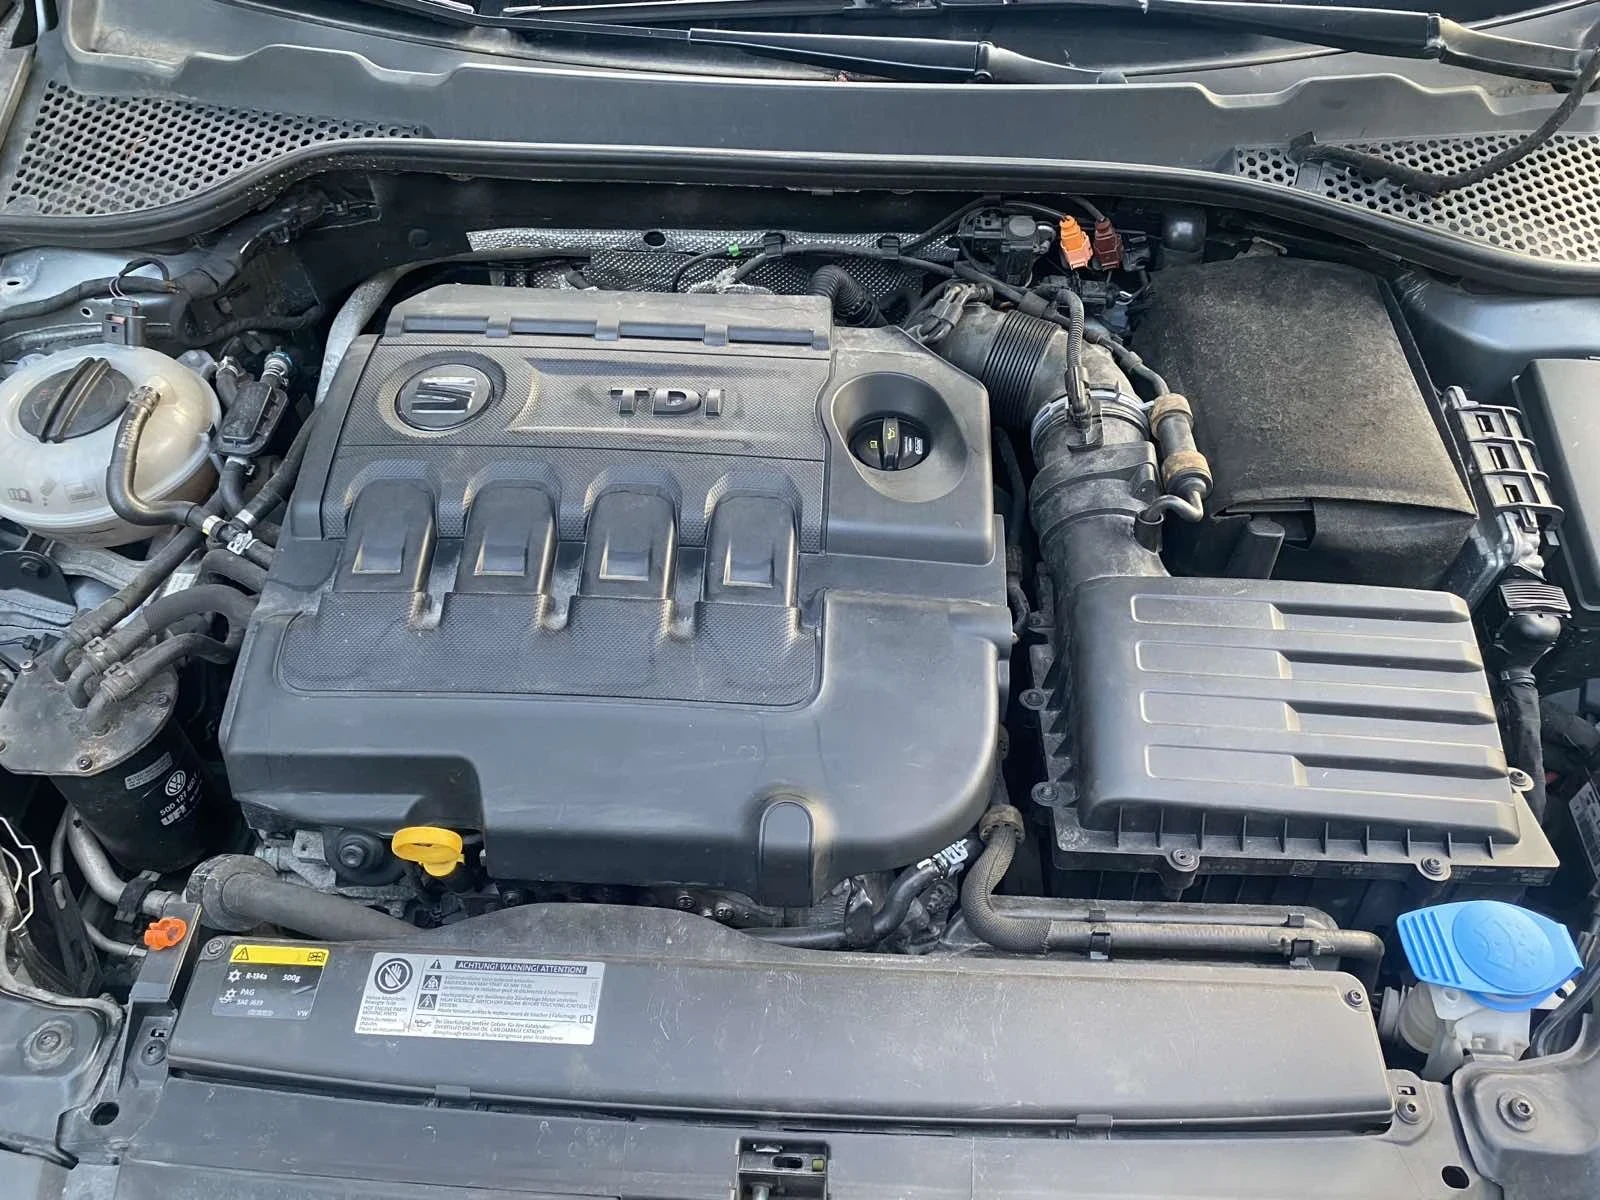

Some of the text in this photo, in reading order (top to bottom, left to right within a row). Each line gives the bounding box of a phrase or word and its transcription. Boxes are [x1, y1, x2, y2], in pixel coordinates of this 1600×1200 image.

[609, 385, 726, 417] TDI
[457, 961, 585, 974] ACHTUNG! WARNING! ATTENTION!
[282, 974, 301, 983] 500g
[240, 988, 256, 996] PAG
